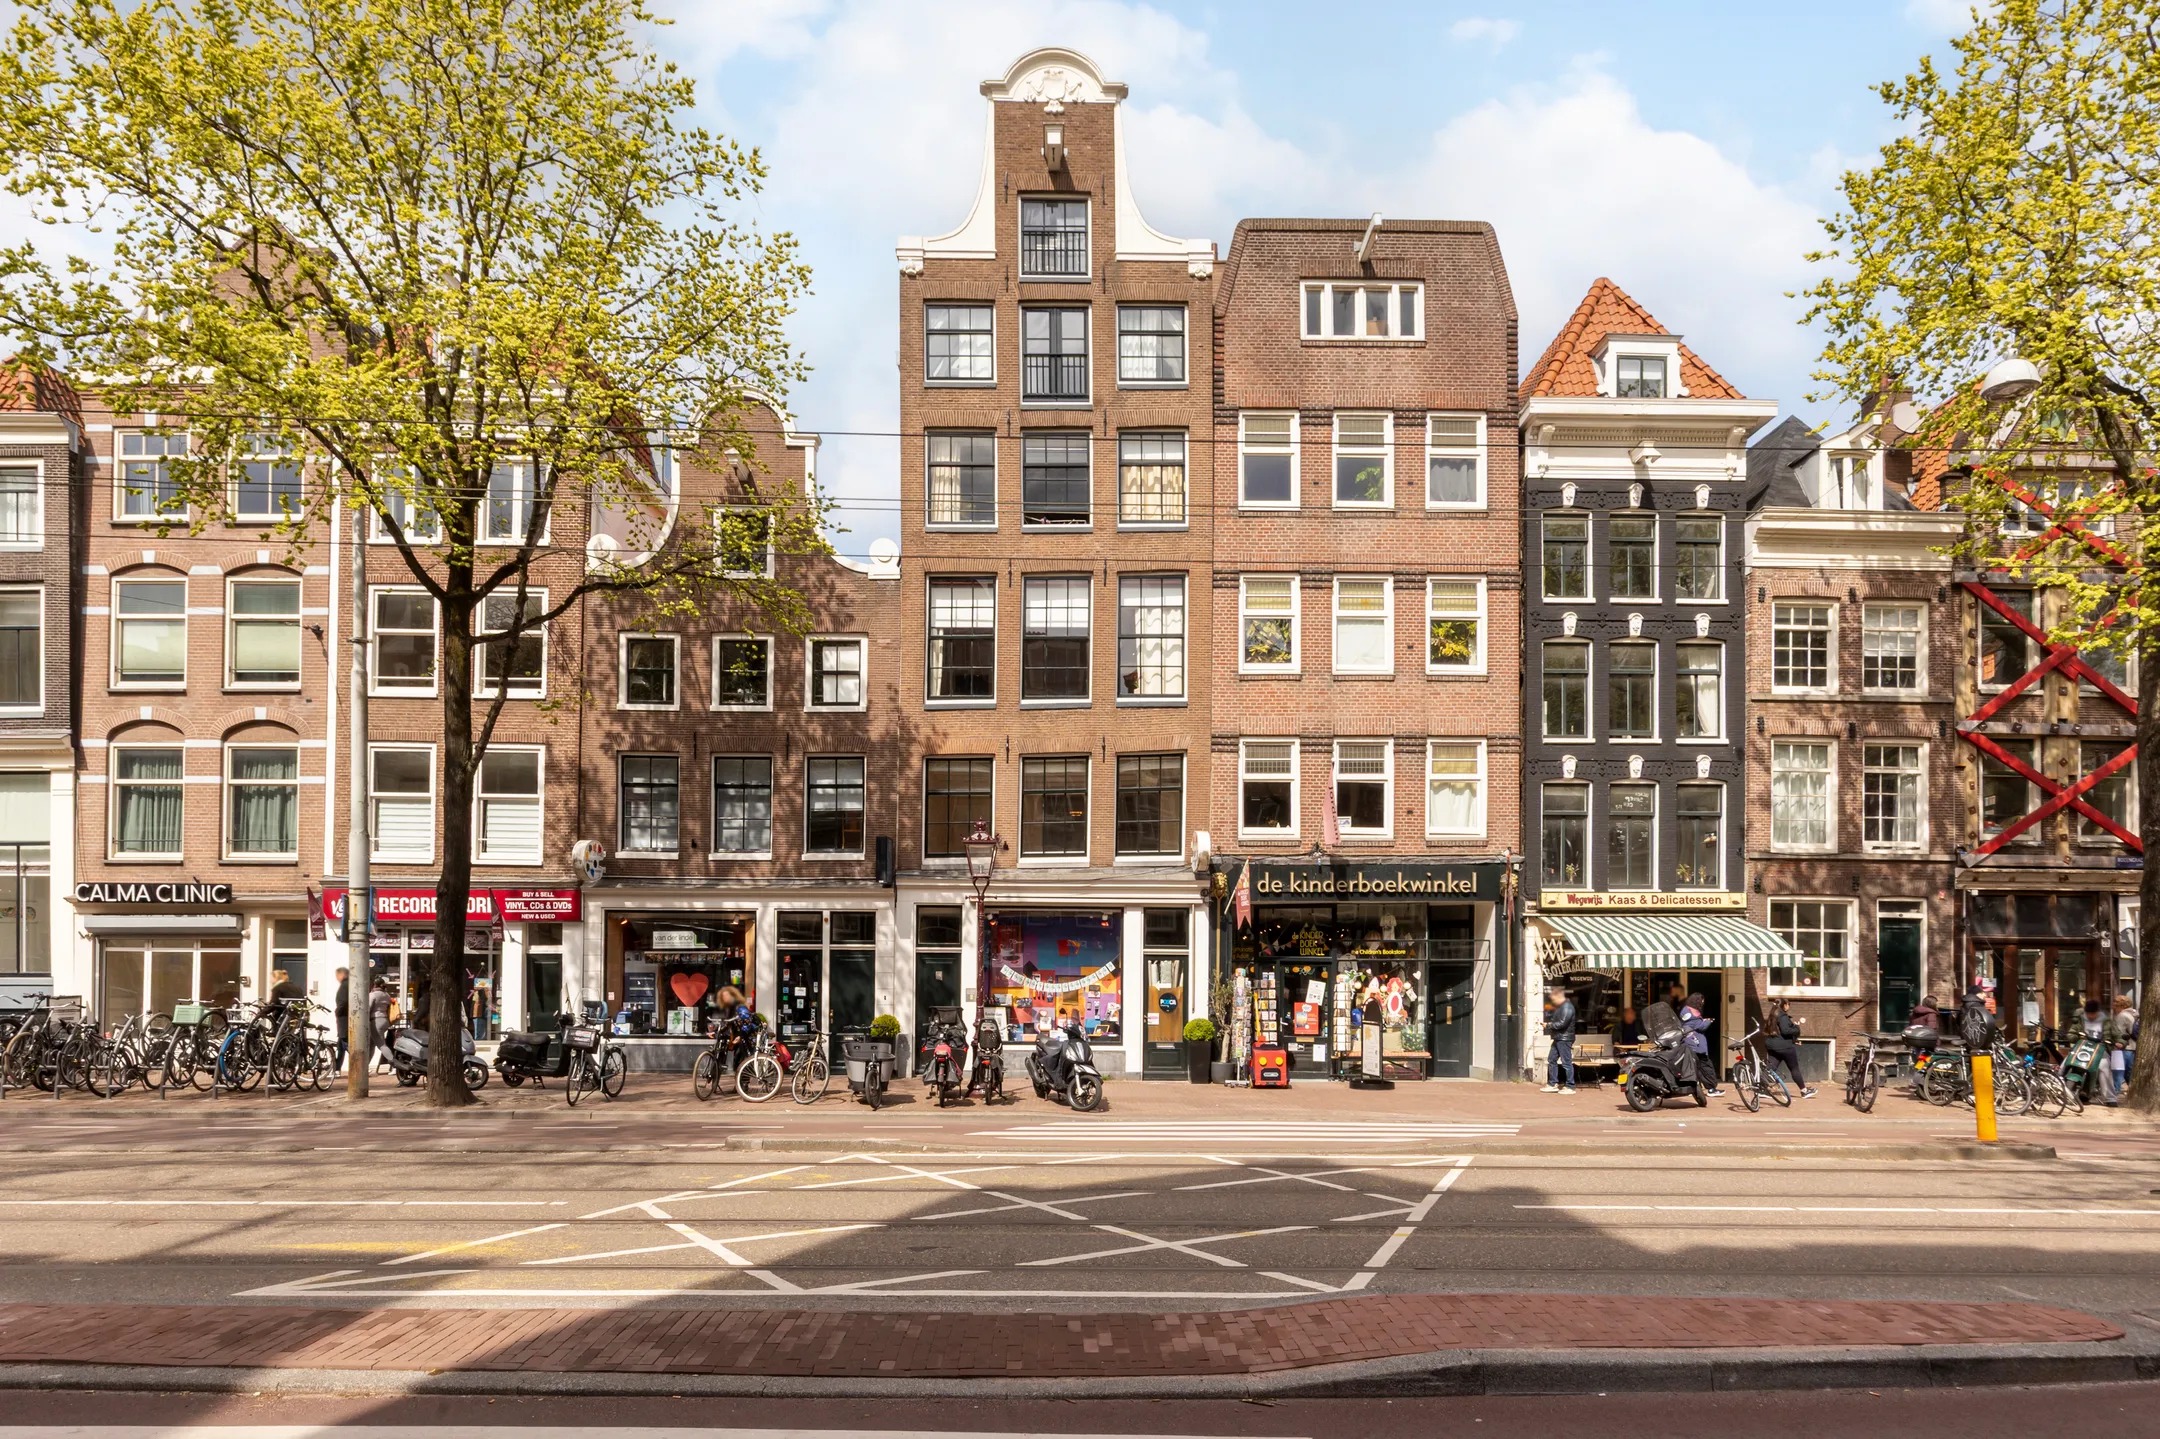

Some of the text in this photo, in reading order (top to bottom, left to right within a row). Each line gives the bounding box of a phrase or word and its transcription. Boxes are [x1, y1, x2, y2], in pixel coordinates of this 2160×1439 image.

[1257, 872, 1477, 893] de kinderboekwinkel
[75, 883, 227, 903] CALMA CLINIC
[1567, 894, 1722, 906] Wegewijs Kaas & Delicatessen
[505, 901, 572, 910] VINYL, CDs & DVDs
[1300, 931, 1323, 939] KINDER
[1300, 940, 1317, 948] BOEK
[1300, 948, 1325, 956] WINKEL
[1545, 961, 1571, 981] BOTER
